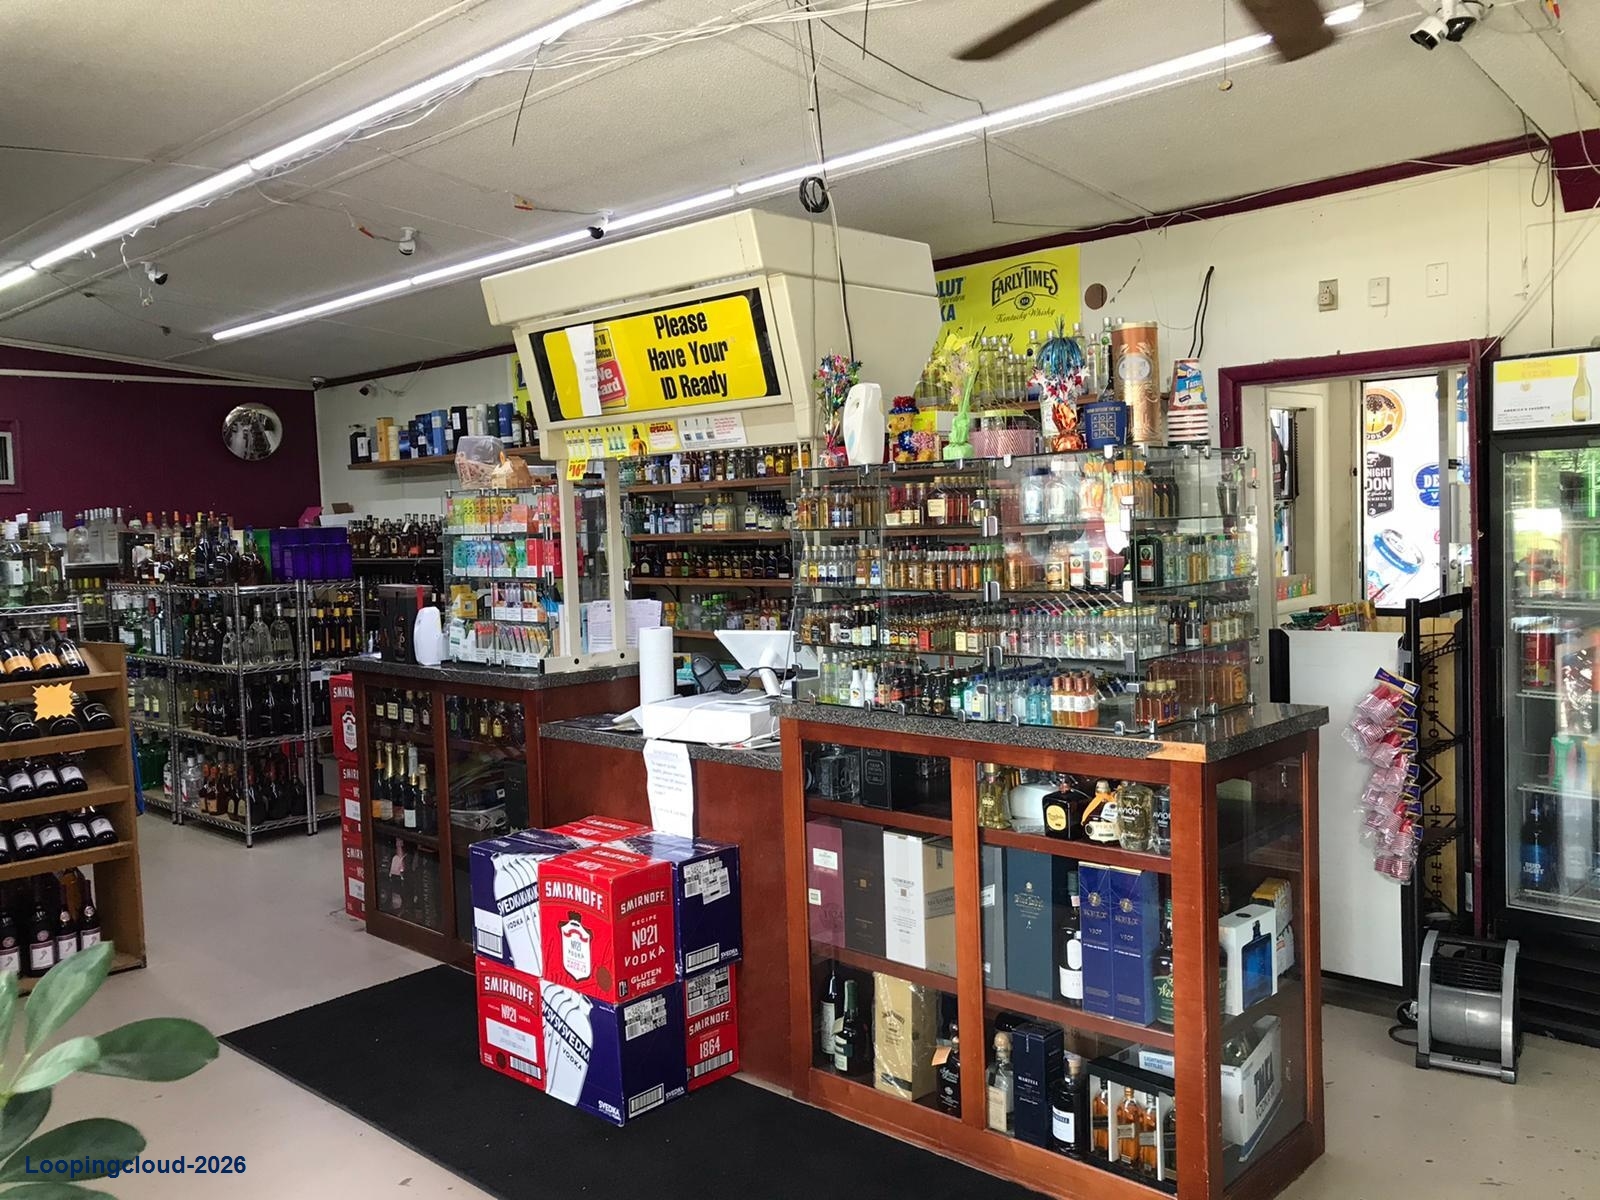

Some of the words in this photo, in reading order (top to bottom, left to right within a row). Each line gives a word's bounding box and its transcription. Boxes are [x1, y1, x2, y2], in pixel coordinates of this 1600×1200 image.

[992, 272, 1023, 307] EARLY
[1020, 266, 1058, 295] TIMES
[653, 312, 708, 339] Please
[994, 313, 1028, 323] Kentucky
[1028, 307, 1056, 317] Whisky
[647, 348, 687, 371] Have
[688, 340, 728, 366] Your
[600, 377, 622, 396] ard
[660, 376, 678, 400] ID
[679, 370, 728, 397] Ready
[1428, 662, 1440, 738] OMPAN
[546, 881, 603, 911] SMIRNOFF
[620, 891, 665, 914] SMIRNOFF
[507, 919, 523, 930] VODKA
[632, 914, 656, 927] RECIPE
[624, 945, 665, 967] VODKA
[631, 967, 662, 984] GLUTEN
[636, 977, 656, 990] FREE
[484, 976, 534, 1006] SMIRNOFF
[689, 1011, 729, 1036] SMIRNOFF
[562, 1047, 582, 1071] VODKA
[700, 1036, 720, 1059] 1864
[598, 1100, 620, 1116] SVEDKA
